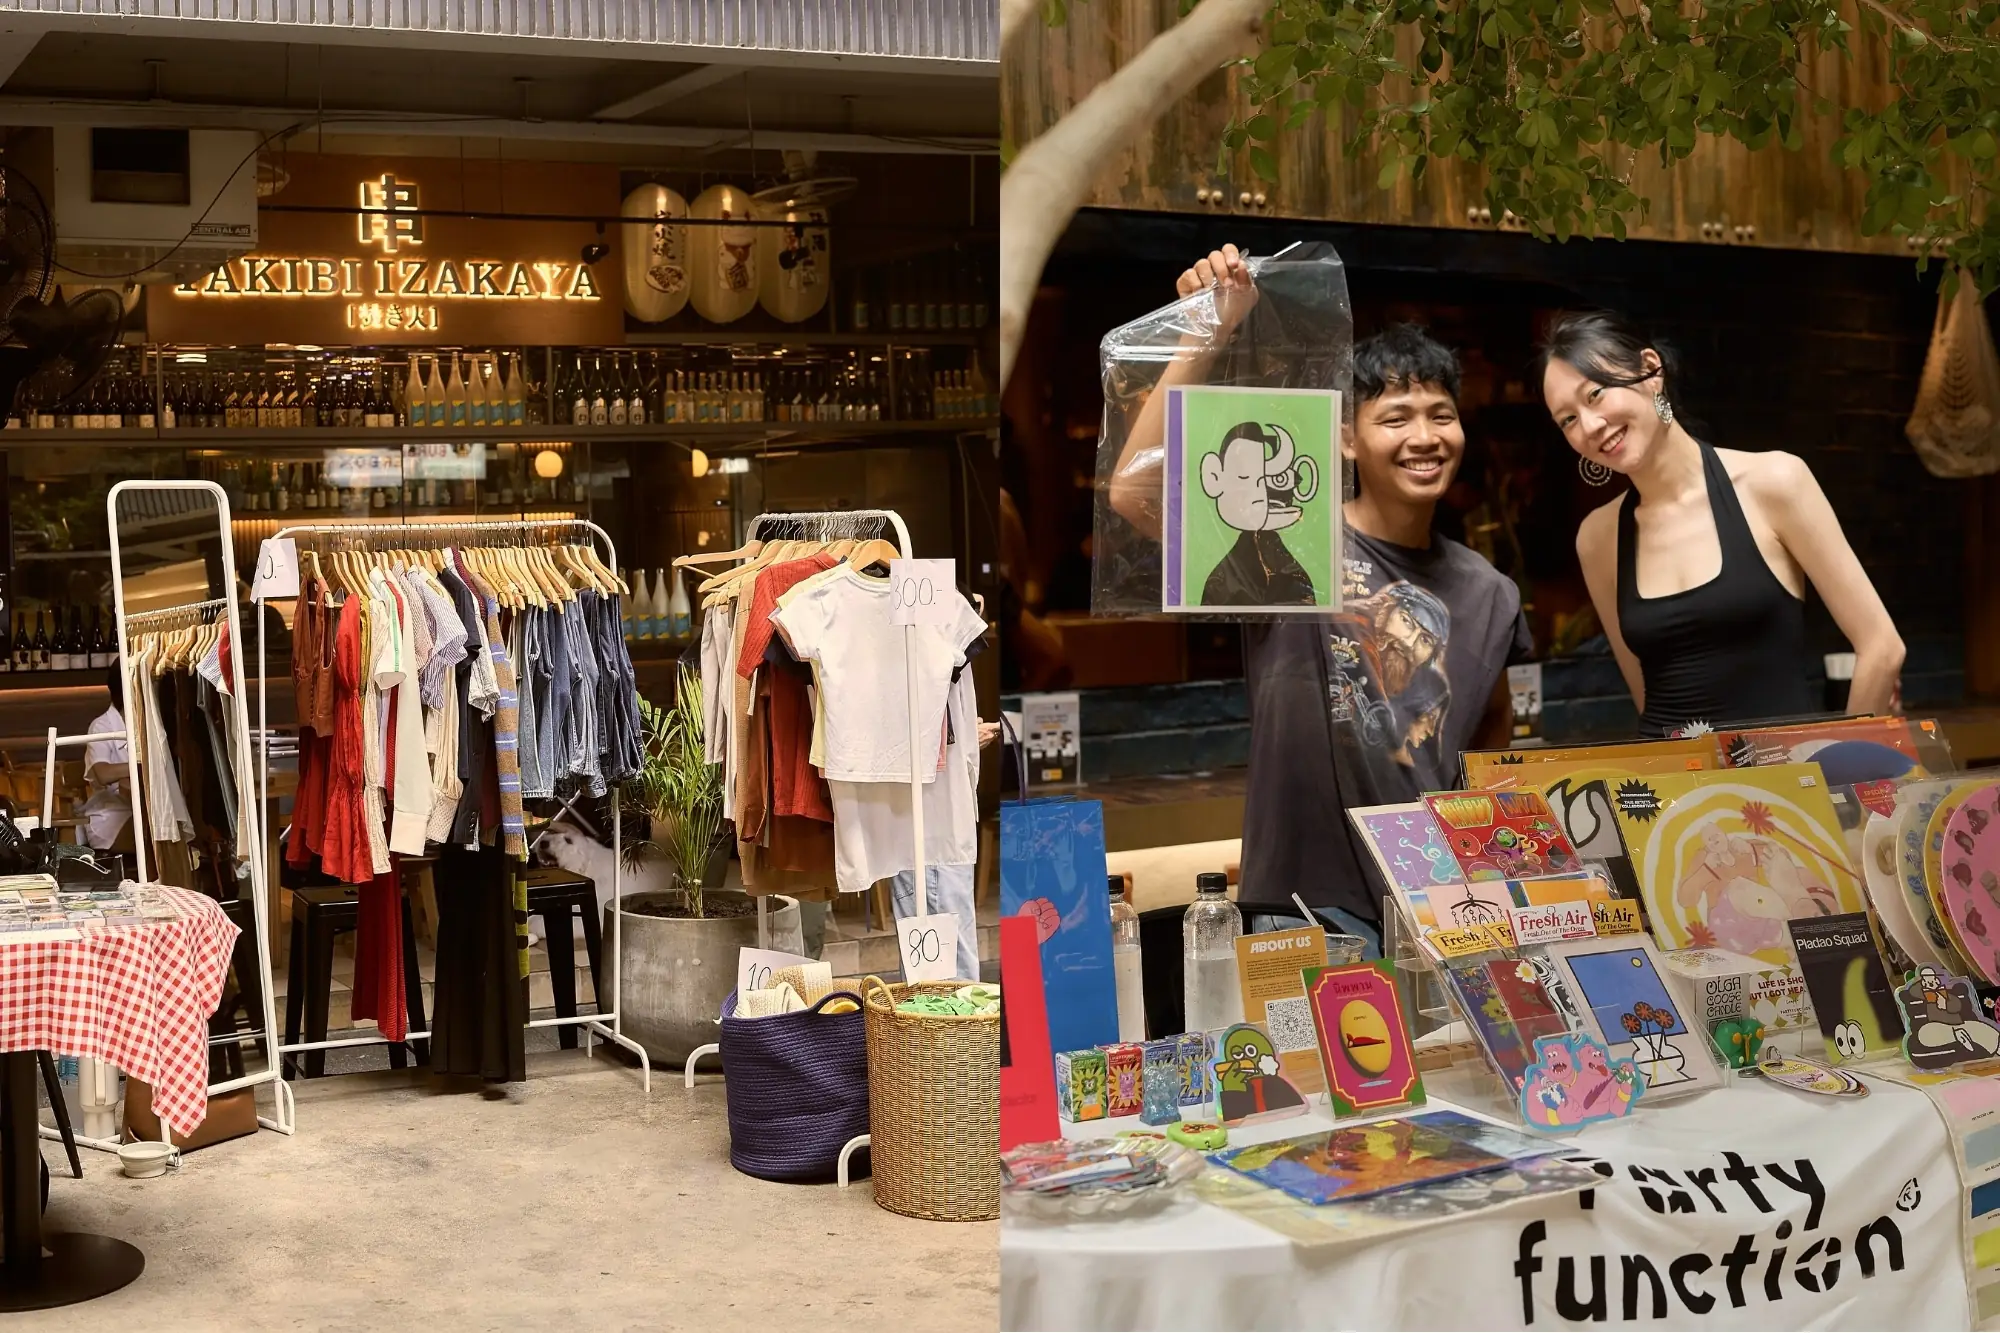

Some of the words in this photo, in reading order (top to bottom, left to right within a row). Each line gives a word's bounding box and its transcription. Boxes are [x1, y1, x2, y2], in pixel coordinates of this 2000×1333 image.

[359, 172, 422, 253] 串
[374, 258, 602, 300] IZAKAYA
[1519, 912, 1561, 932] Fresh
[1564, 909, 1588, 926] Air
[1612, 907, 1634, 922] Air
[1250, 938, 1294, 954] ABOUT
[1296, 935, 1312, 947] US
[1440, 931, 1481, 947] Fresh
[1796, 936, 1833, 950] Pladao
[1833, 932, 1868, 947] Squad
[1758, 980, 1776, 989] LIFE
[1777, 978, 1786, 986] IS
[1787, 976, 1804, 985] SHO
[1769, 988, 1786, 997] GOT
[1787, 985, 1804, 995] HEA
[1514, 1214, 1906, 1325] function
